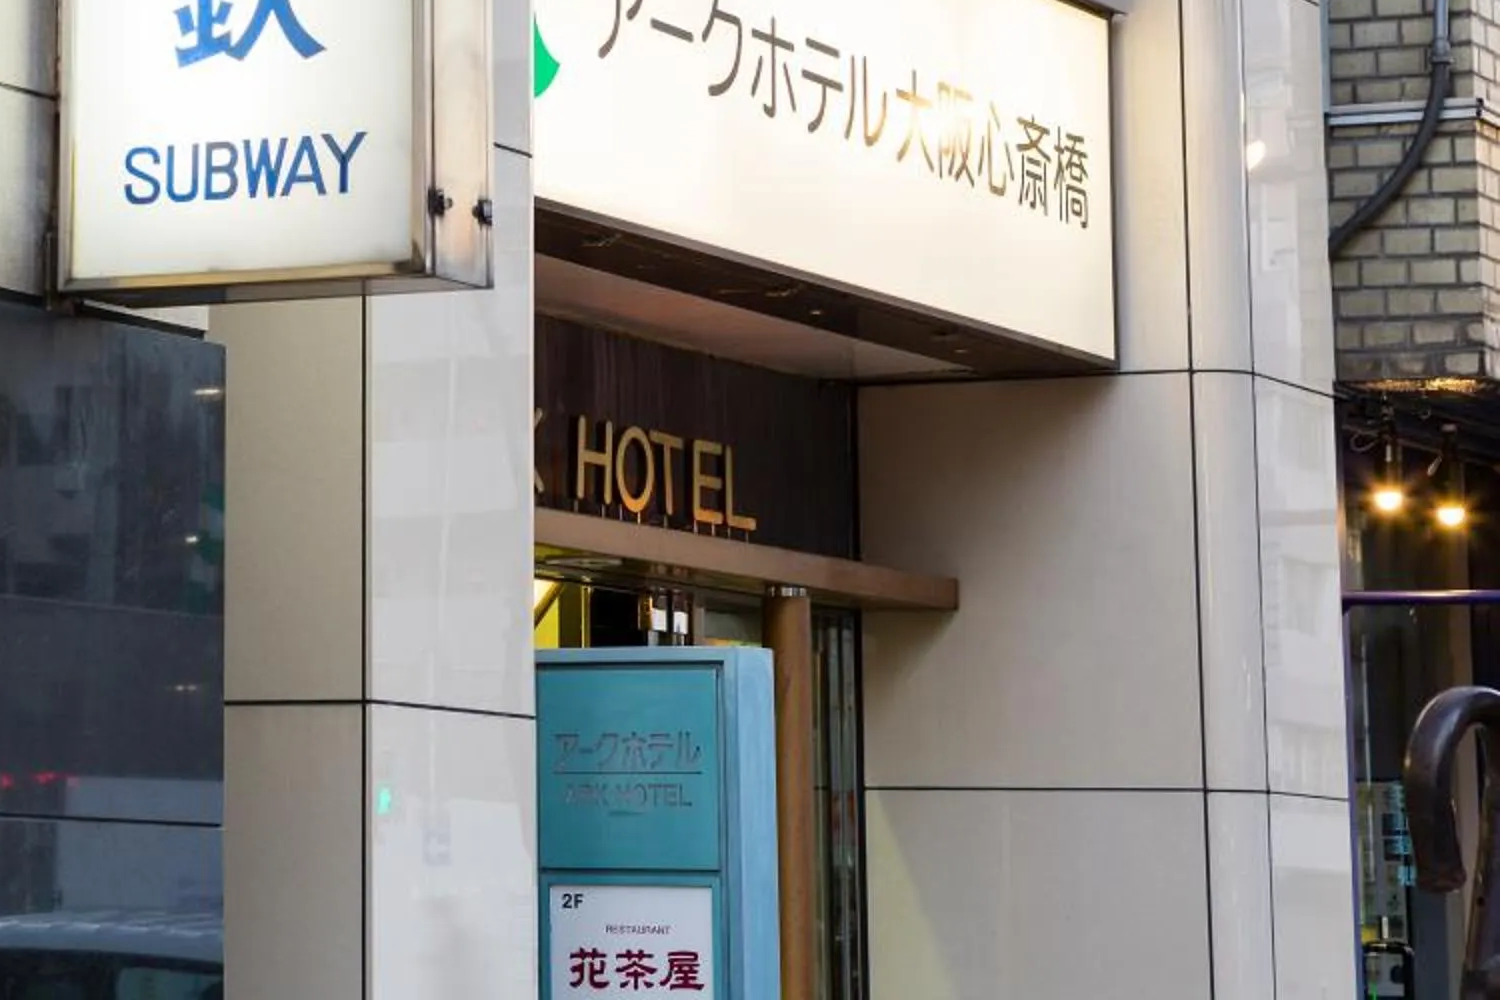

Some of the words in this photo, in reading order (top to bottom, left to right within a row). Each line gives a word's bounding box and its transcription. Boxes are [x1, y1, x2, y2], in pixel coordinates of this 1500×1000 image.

[123, 130, 369, 206] SUBWAY
[577, 414, 757, 531] HOTEL
[554, 731, 701, 771] アークホテル
[613, 783, 693, 808] HOTEL
[562, 893, 584, 909] 2F
[605, 924, 672, 936] RESTAURANT
[569, 947, 705, 991] 花茶屋
